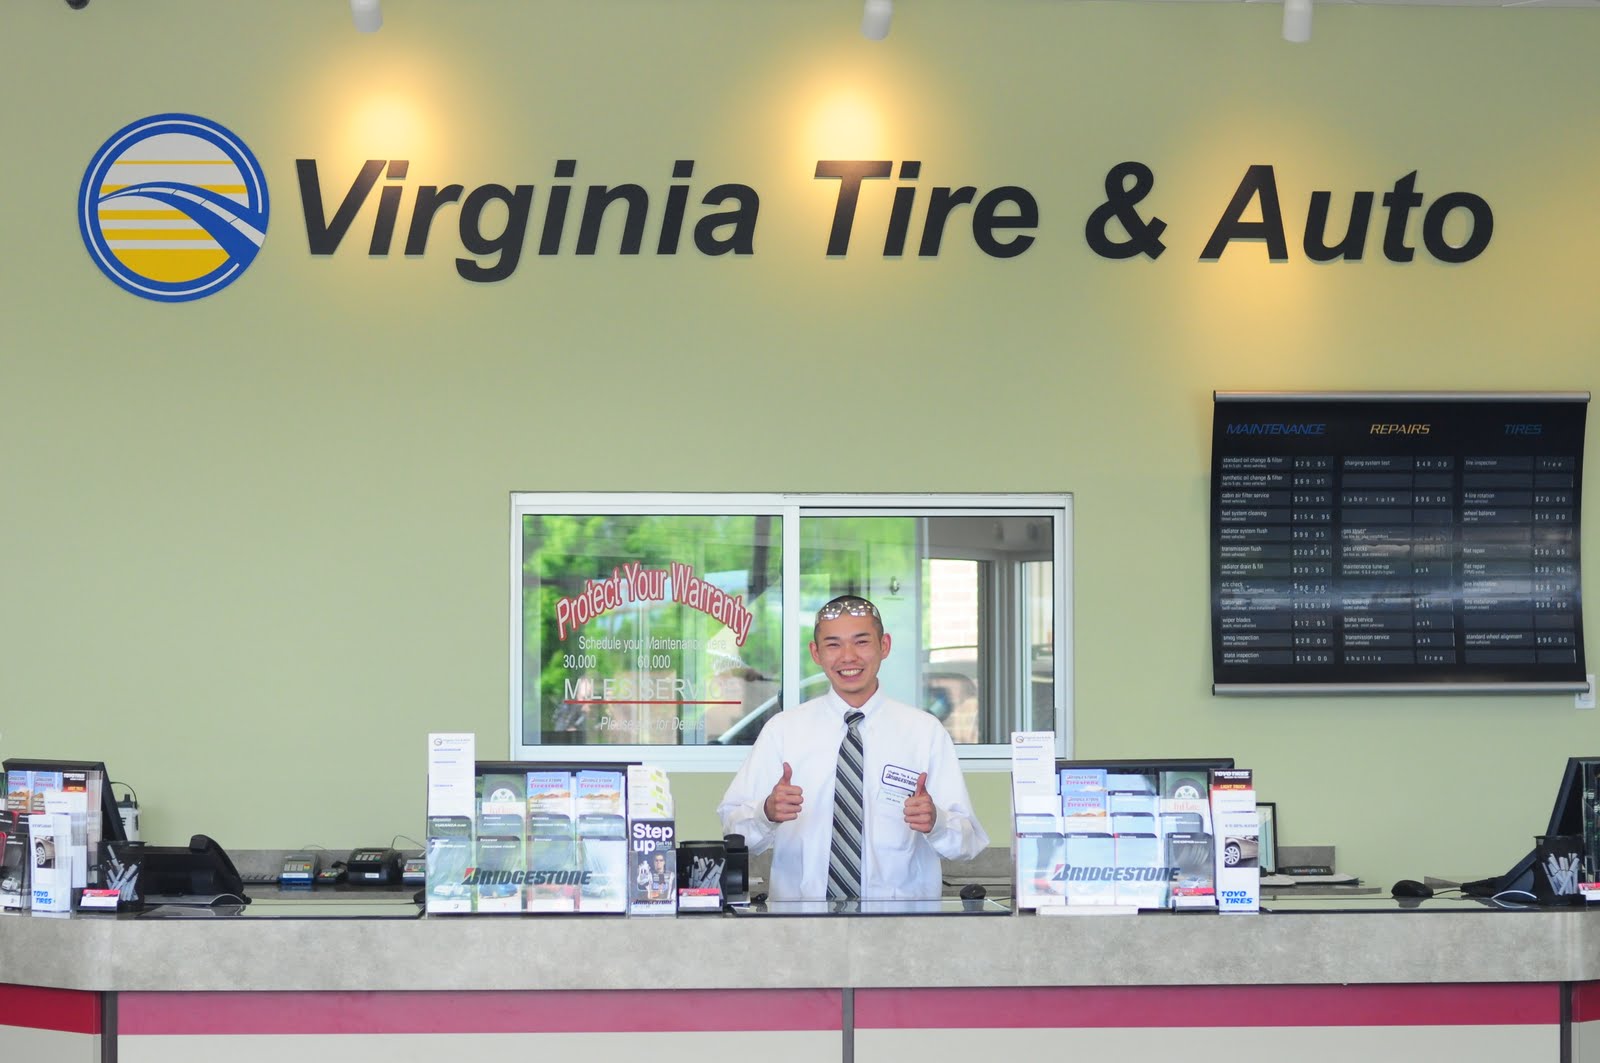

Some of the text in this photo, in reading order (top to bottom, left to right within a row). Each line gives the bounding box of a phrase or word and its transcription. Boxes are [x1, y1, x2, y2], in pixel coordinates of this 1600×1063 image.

[295, 159, 1494, 283] Virginia Tire & Auto
[1226, 423, 1327, 435] MAINTENANCE
[1370, 423, 1431, 435] REPAIRS
[1504, 423, 1543, 435] TIRES
[556, 561, 752, 647] Protect Your Warranty
[578, 636, 621, 650] Schedule
[623, 639, 644, 653] your
[563, 655, 596, 669] 30,000
[638, 655, 670, 669] 60,000
[633, 823, 673, 841] Step
[633, 840, 656, 855] up
[461, 867, 592, 885] BRIDGESTONE
[1052, 863, 1180, 881] BRIDGESTONE
